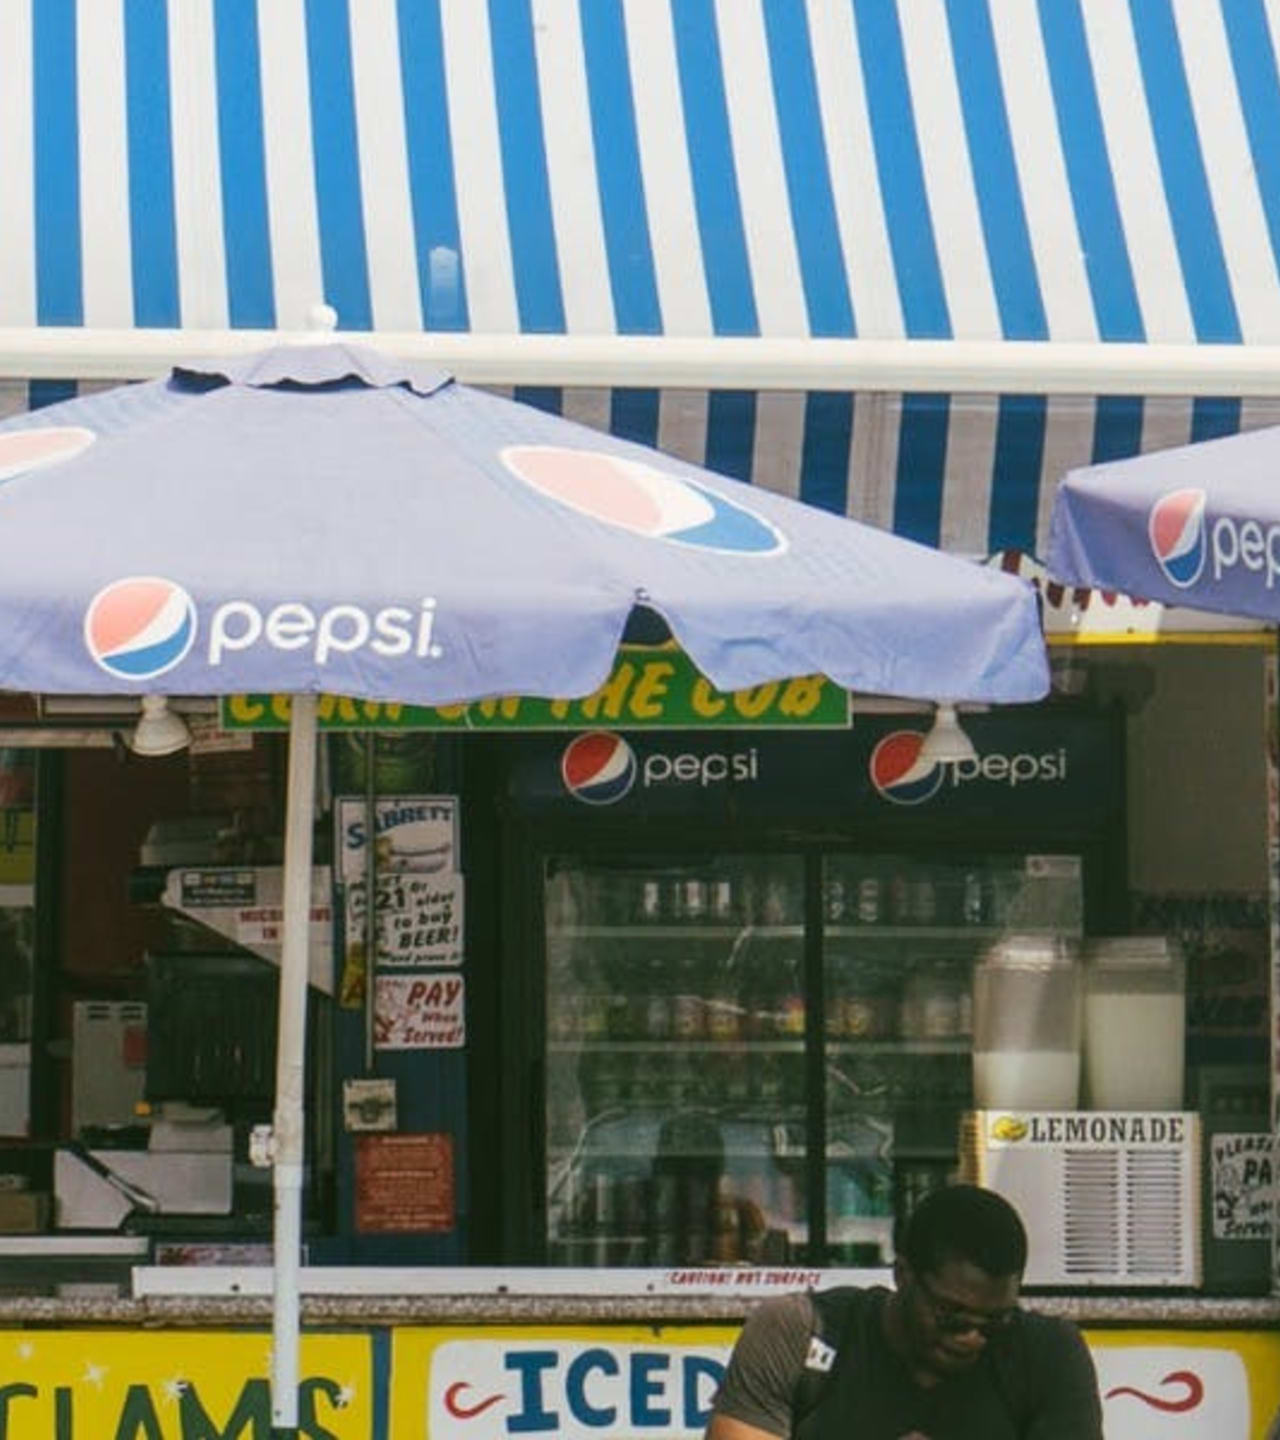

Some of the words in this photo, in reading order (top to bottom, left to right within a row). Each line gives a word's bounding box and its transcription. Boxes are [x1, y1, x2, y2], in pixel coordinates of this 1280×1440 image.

[644, 748, 758, 786] pepsi
[953, 749, 1066, 786] pepsi
[406, 980, 461, 1007] PAY
[1030, 1116, 1185, 1143] LEMONADE
[1244, 1159, 1273, 1185] PA
[503, 1348, 726, 1433] ICED
